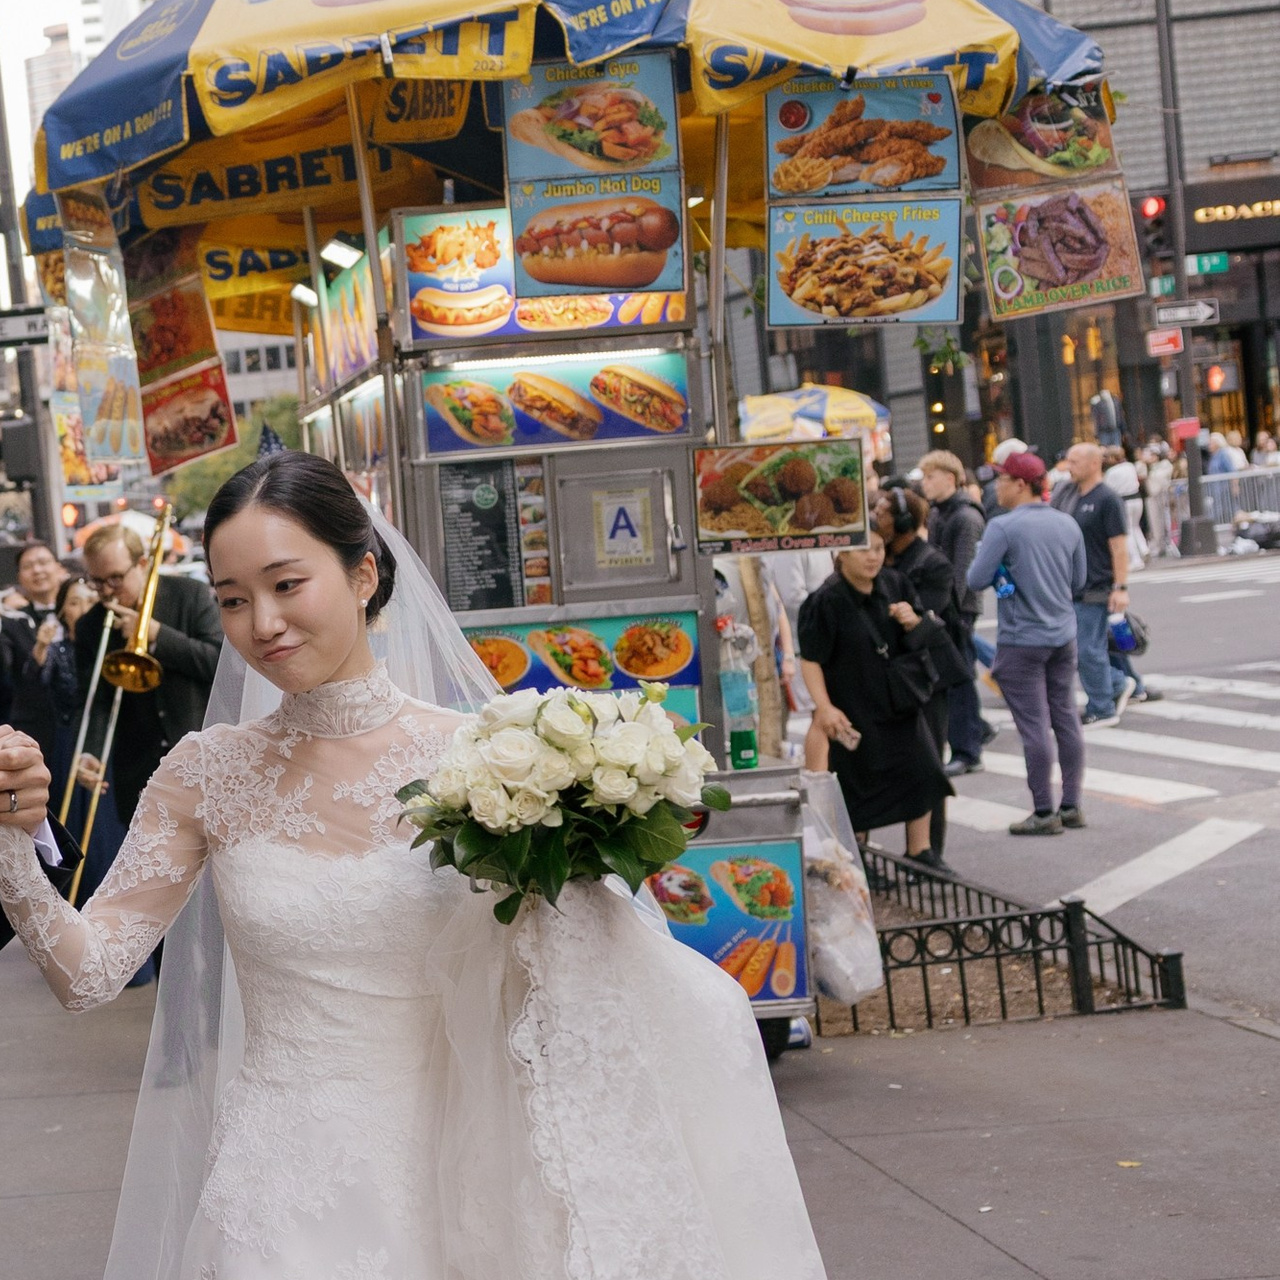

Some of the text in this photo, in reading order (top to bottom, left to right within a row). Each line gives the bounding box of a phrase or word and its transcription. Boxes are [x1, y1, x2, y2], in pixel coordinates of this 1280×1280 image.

[608, 61, 640, 78] Gyro
[782, 81, 835, 96] Chicken
[60, 132, 101, 161] WE'RE
[103, 124, 122, 148] ON
[123, 120, 133, 140] A
[149, 144, 394, 210] SABRETT
[542, 175, 661, 198] Jumbo Hot Dog
[803, 206, 940, 225] Chili Cheese Fries
[1002, 275, 1131, 312] LAMB OVER RICE
[27, 320, 49, 333] WA
[608, 506, 638, 540] A
[780, 535, 816, 550] Over
